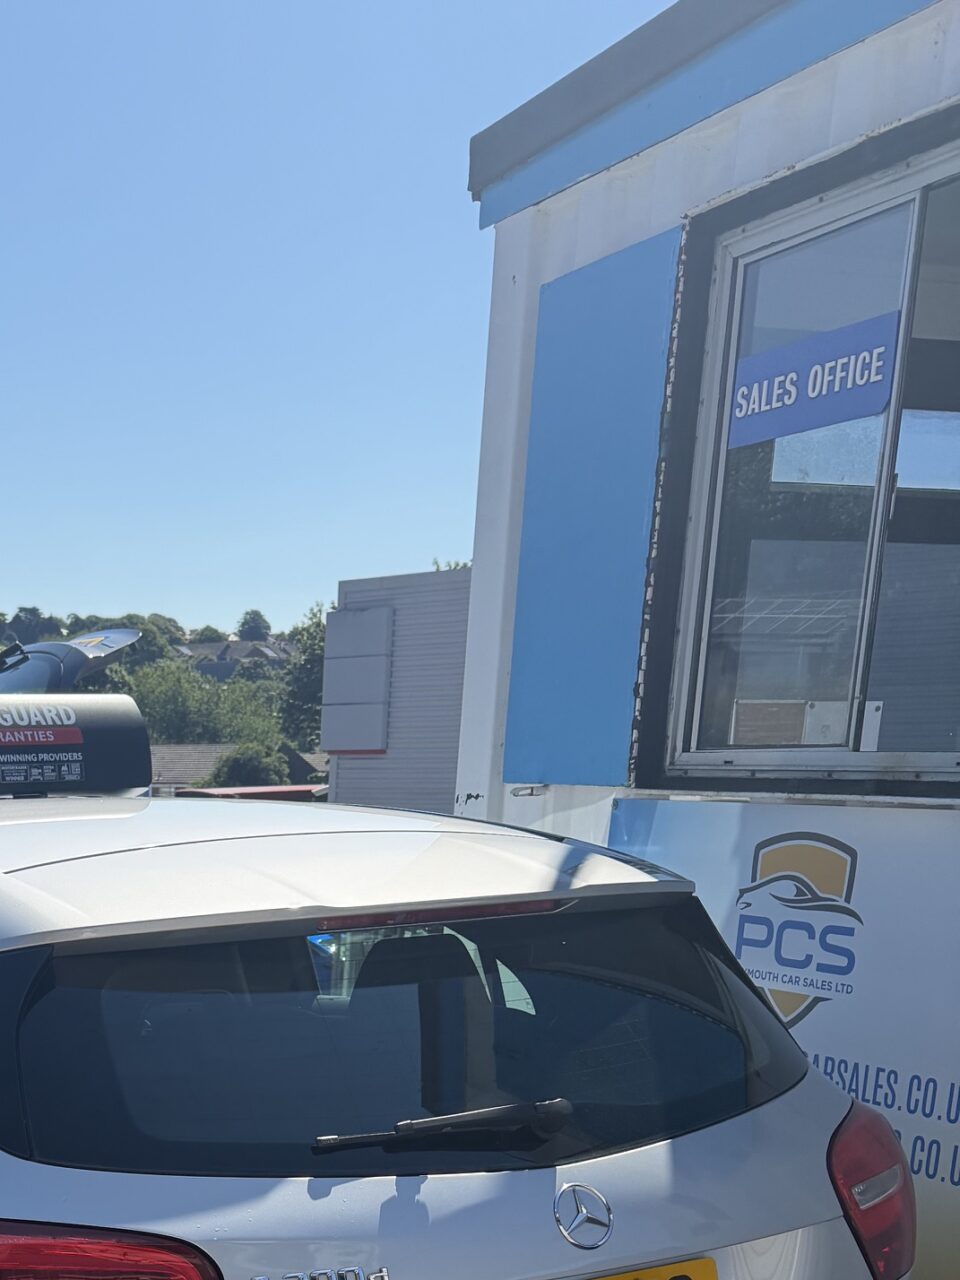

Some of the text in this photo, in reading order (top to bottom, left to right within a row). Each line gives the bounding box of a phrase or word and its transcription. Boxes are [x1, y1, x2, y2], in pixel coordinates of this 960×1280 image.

[735, 346, 885, 418] SALES OFFICE
[0, 754, 37, 763] WINNING
[38, 752, 83, 762] PROVIDERS
[735, 914, 855, 976] PCS
[781, 974, 800, 986] CAR
[802, 977, 833, 991] SALES
[835, 983, 854, 995] LTD
